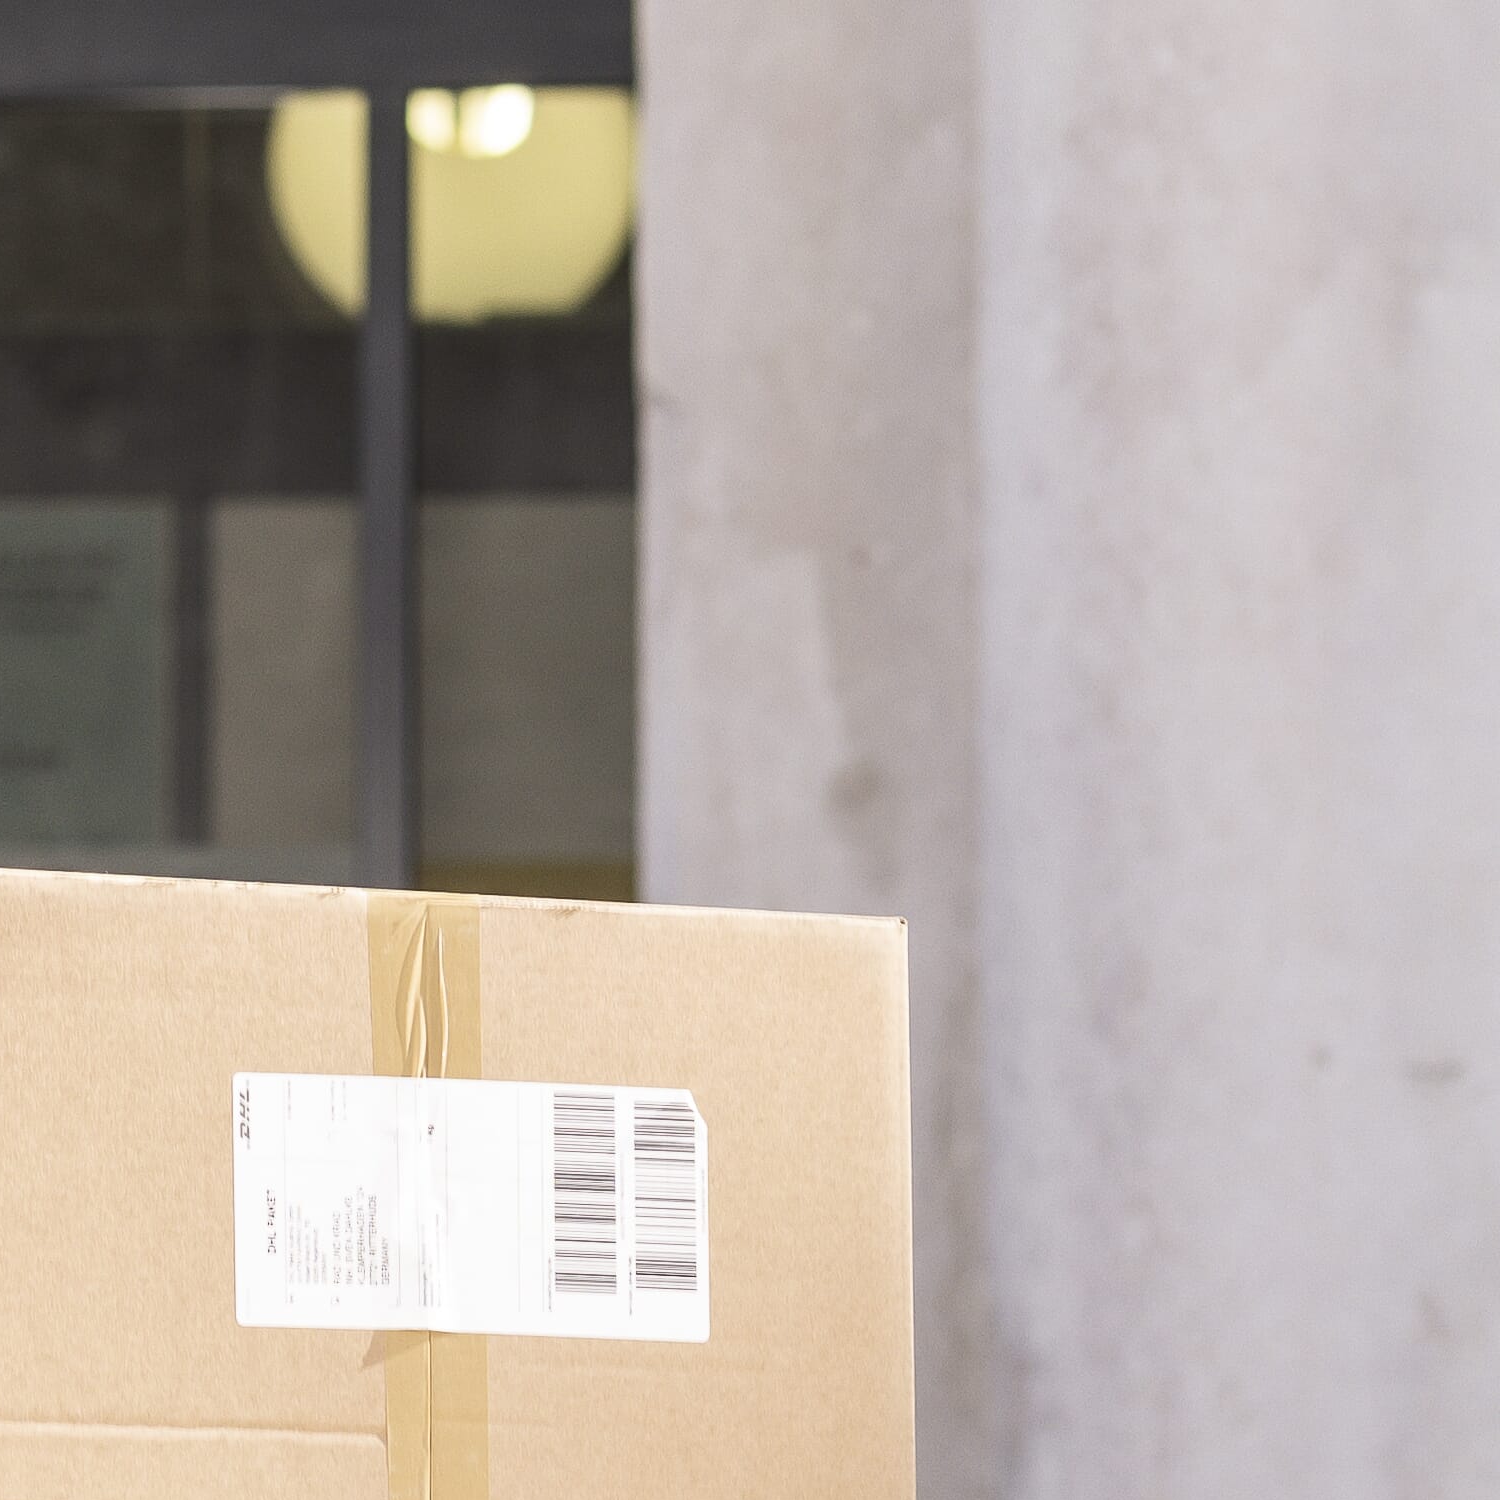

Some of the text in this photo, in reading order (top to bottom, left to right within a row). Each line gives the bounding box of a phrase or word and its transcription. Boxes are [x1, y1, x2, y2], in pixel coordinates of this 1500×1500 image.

[240, 1087, 250, 1139] DHL
[266, 1189, 276, 1254] DHL PAKET
